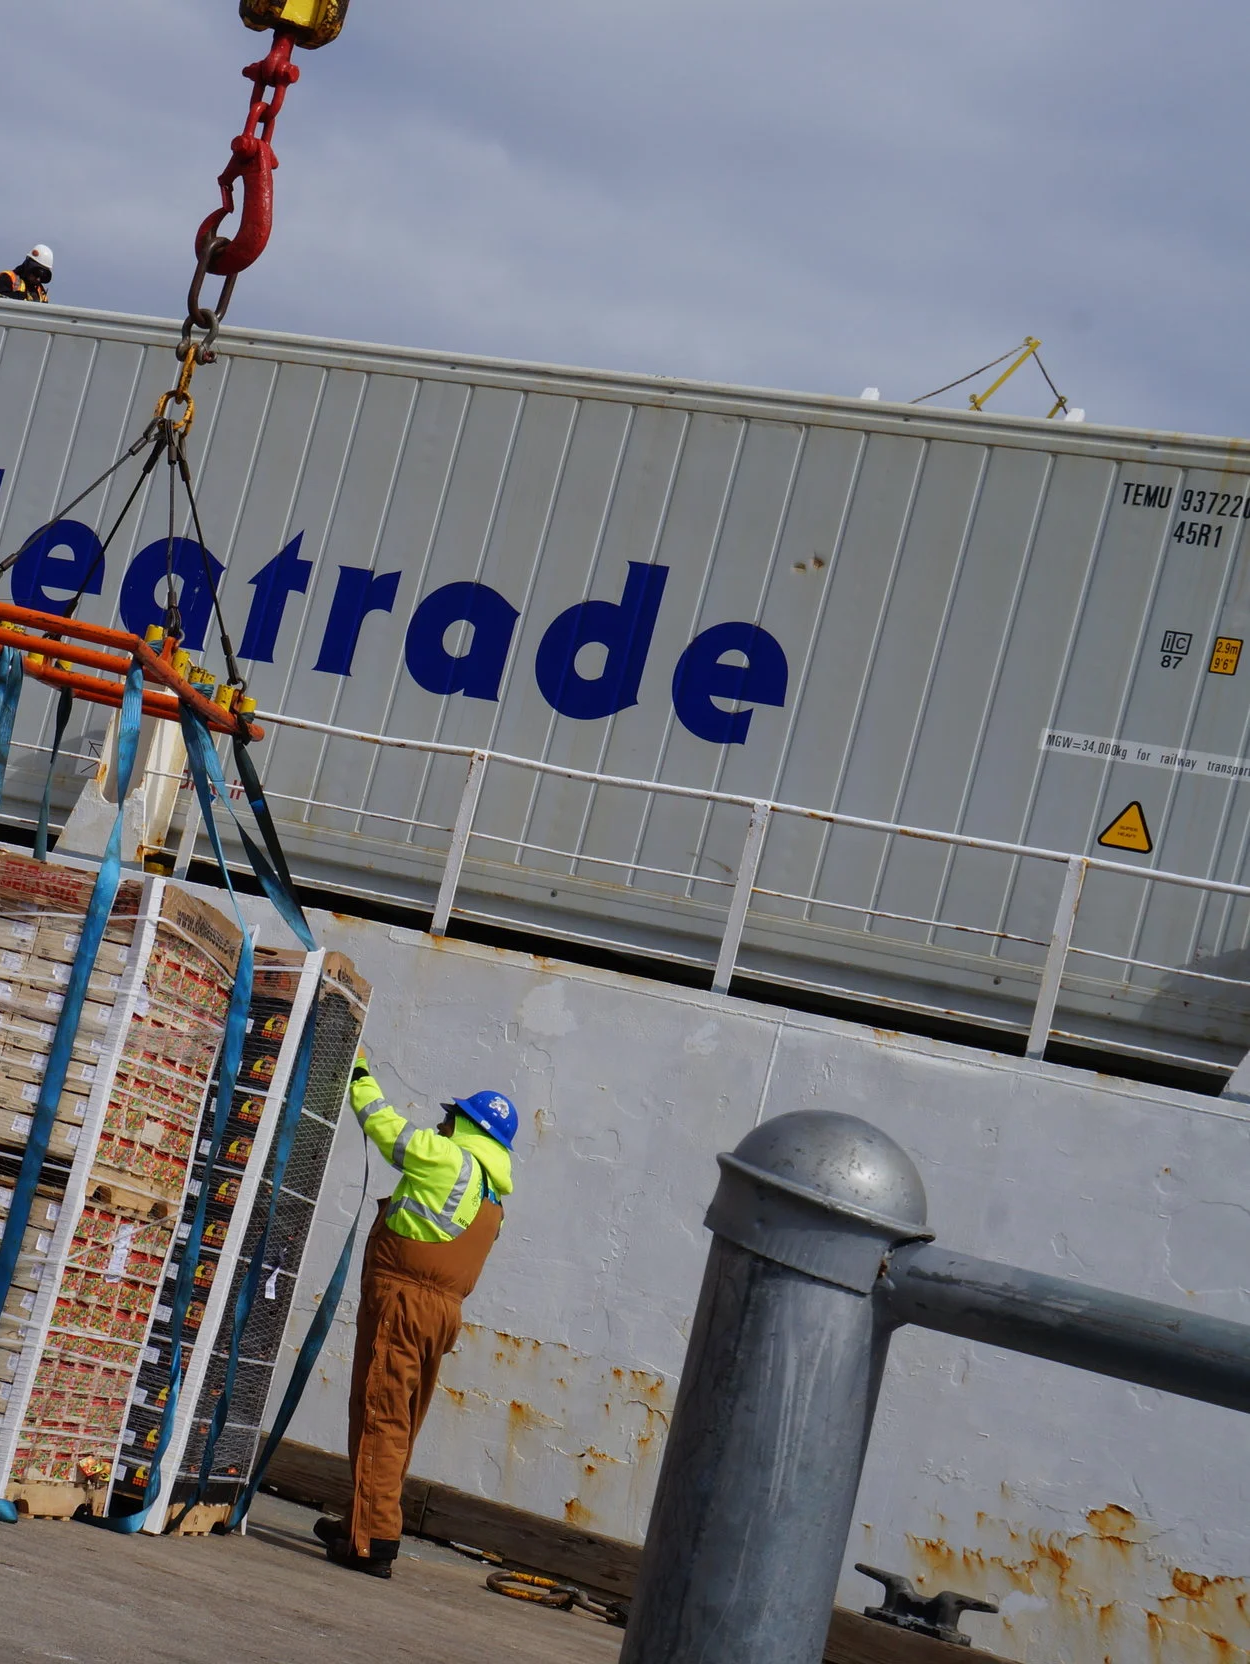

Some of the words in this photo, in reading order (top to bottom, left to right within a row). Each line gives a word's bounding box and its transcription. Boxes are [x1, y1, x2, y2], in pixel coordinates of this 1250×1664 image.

[1123, 483, 1172, 508] TEMU
[1173, 521, 1223, 548] 45R1
[1216, 642, 1238, 655] 2.9m
[1161, 655, 1183, 670] 87
[1046, 735, 1128, 760] MGW=34,000kg
[1137, 748, 1150, 761] for
[1160, 754, 1197, 770] railway
